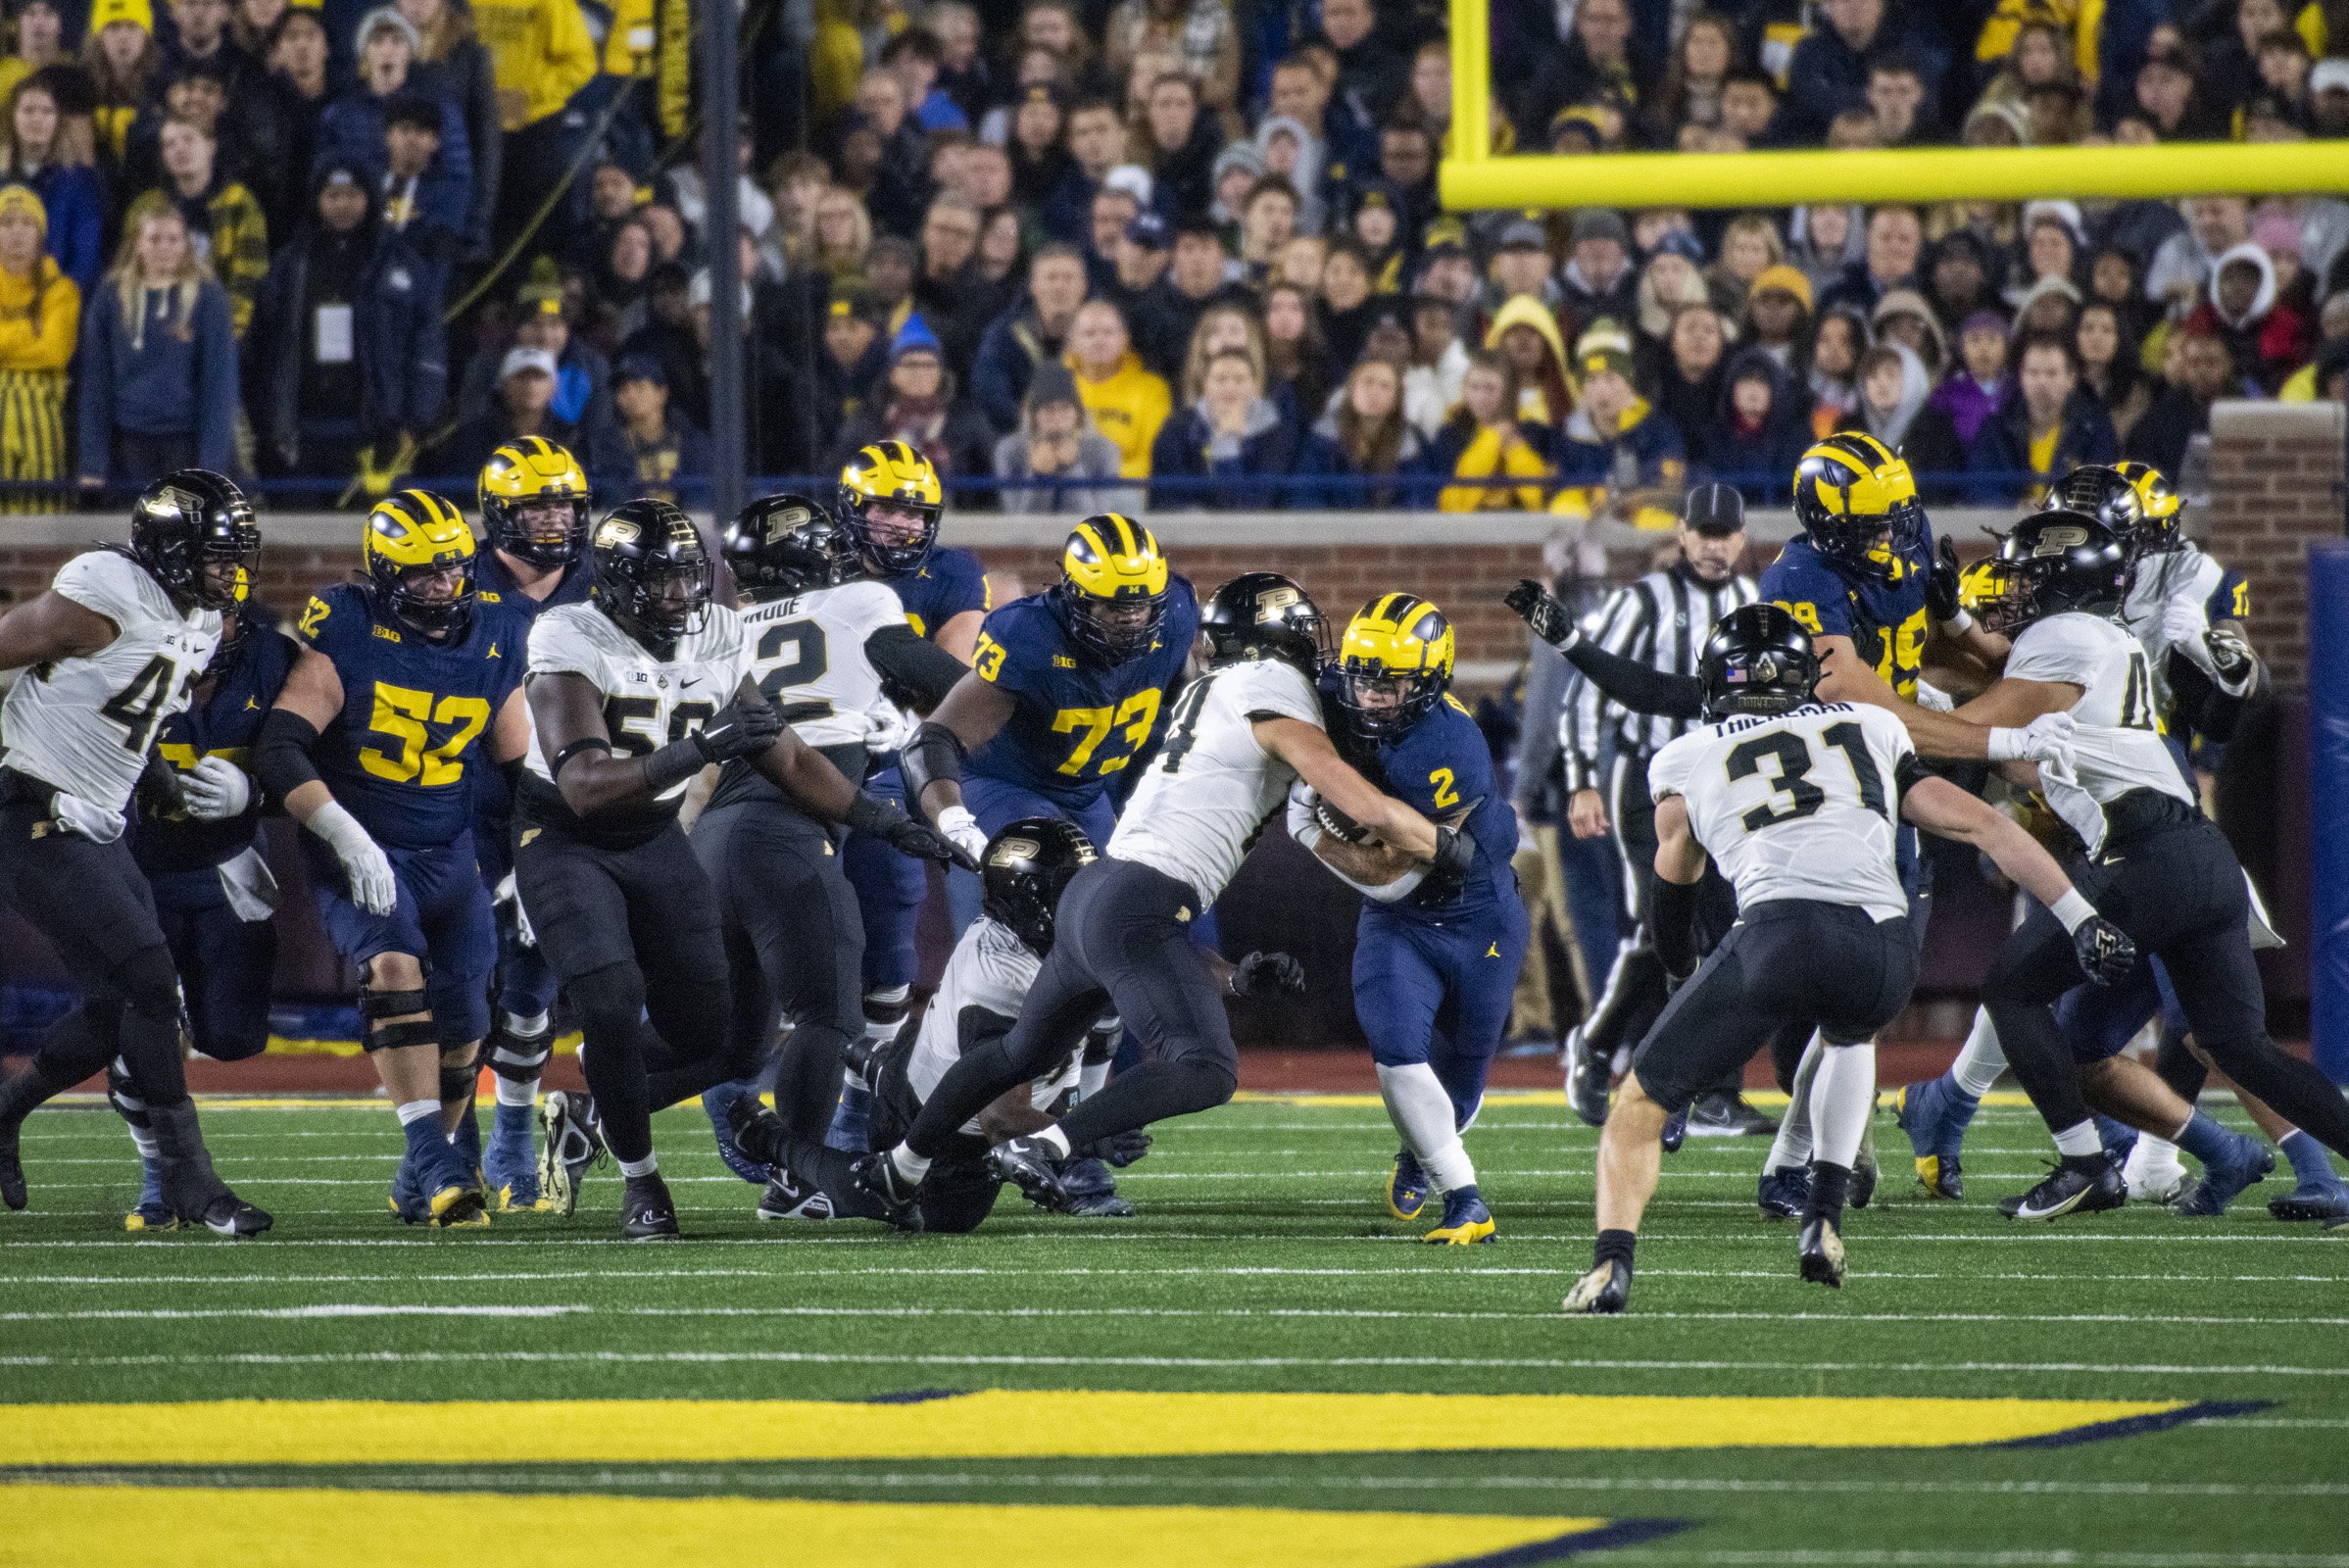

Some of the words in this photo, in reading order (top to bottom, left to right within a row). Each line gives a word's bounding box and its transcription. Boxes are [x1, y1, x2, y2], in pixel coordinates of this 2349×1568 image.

[595, 518, 642, 550] P
[766, 507, 810, 545] P
[2032, 526, 2087, 557] P
[1255, 588, 1298, 624] P
[972, 631, 1006, 682] 73
[359, 680, 492, 786] 52
[1052, 687, 1162, 777] 73
[1715, 702, 1854, 738] THIMAN
[1429, 767, 1459, 808] 2
[1725, 721, 1894, 834] 31
[990, 837, 1041, 867] P
